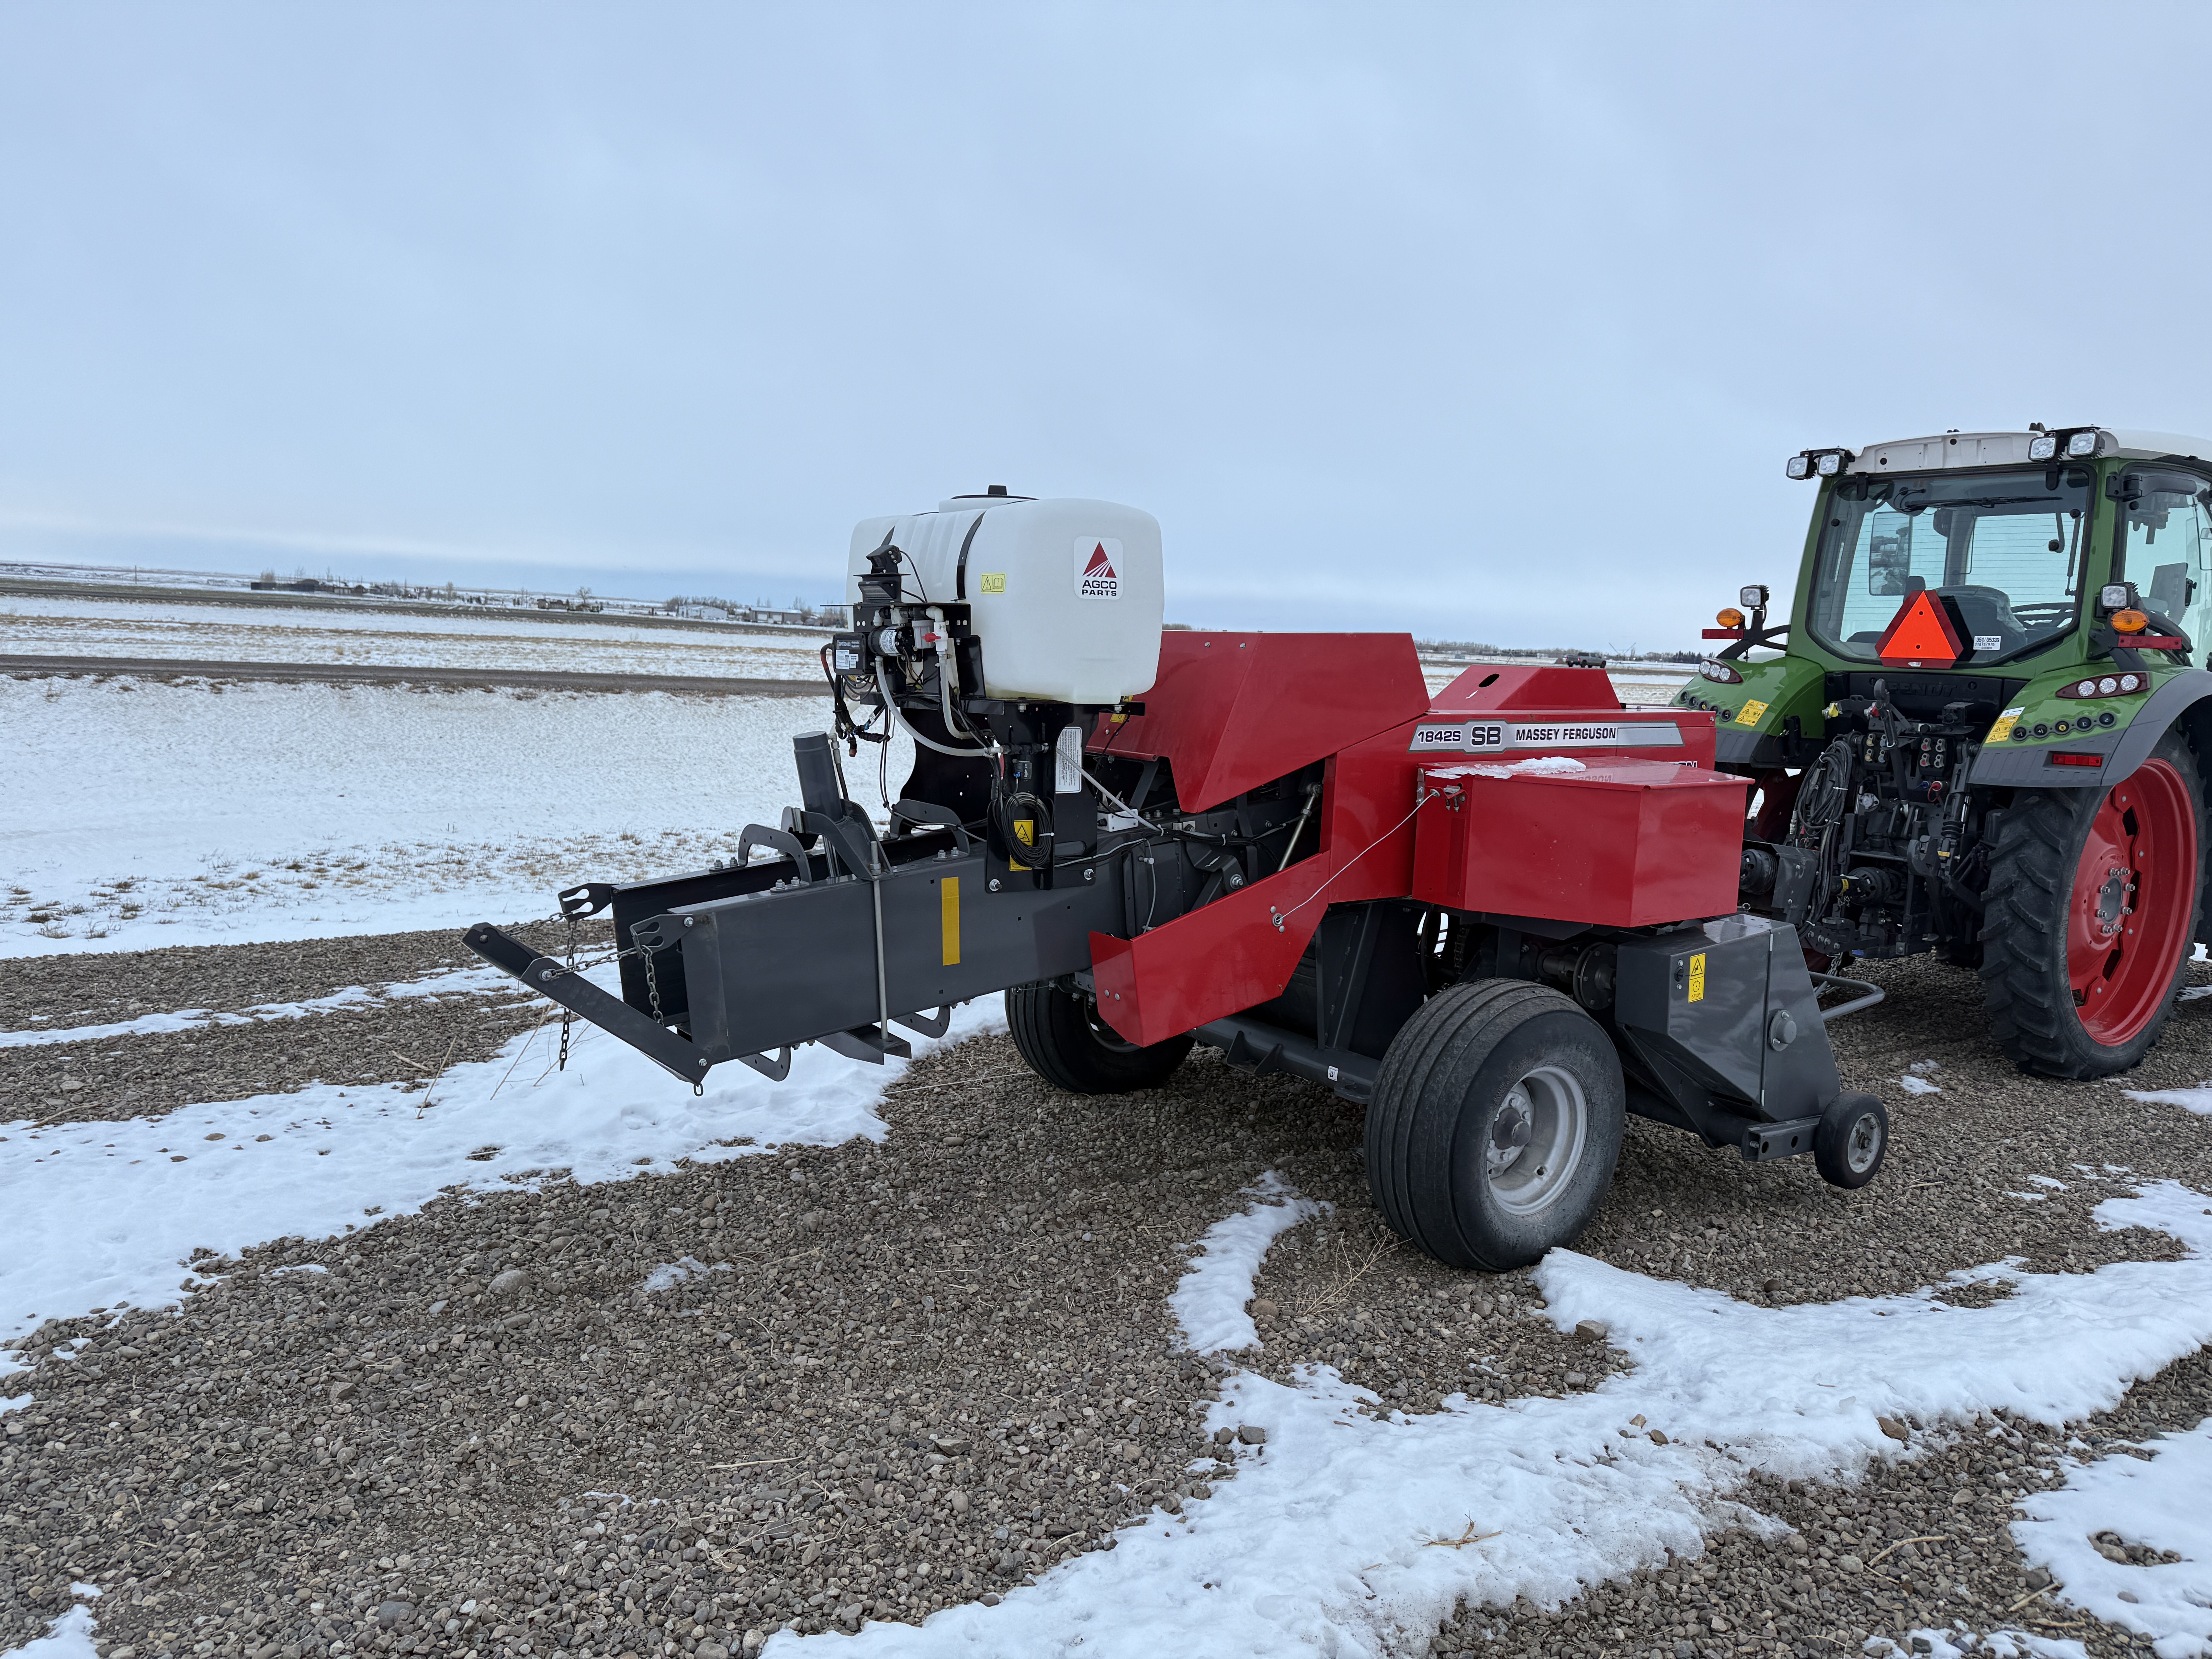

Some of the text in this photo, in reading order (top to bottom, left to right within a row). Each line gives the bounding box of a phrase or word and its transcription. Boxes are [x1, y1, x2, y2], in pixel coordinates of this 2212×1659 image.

[1082, 580, 1117, 589] AGCO
[1887, 682, 1957, 697] FENDT
[1418, 726, 1616, 745] 1842S SB MASSEY FERGUSON
